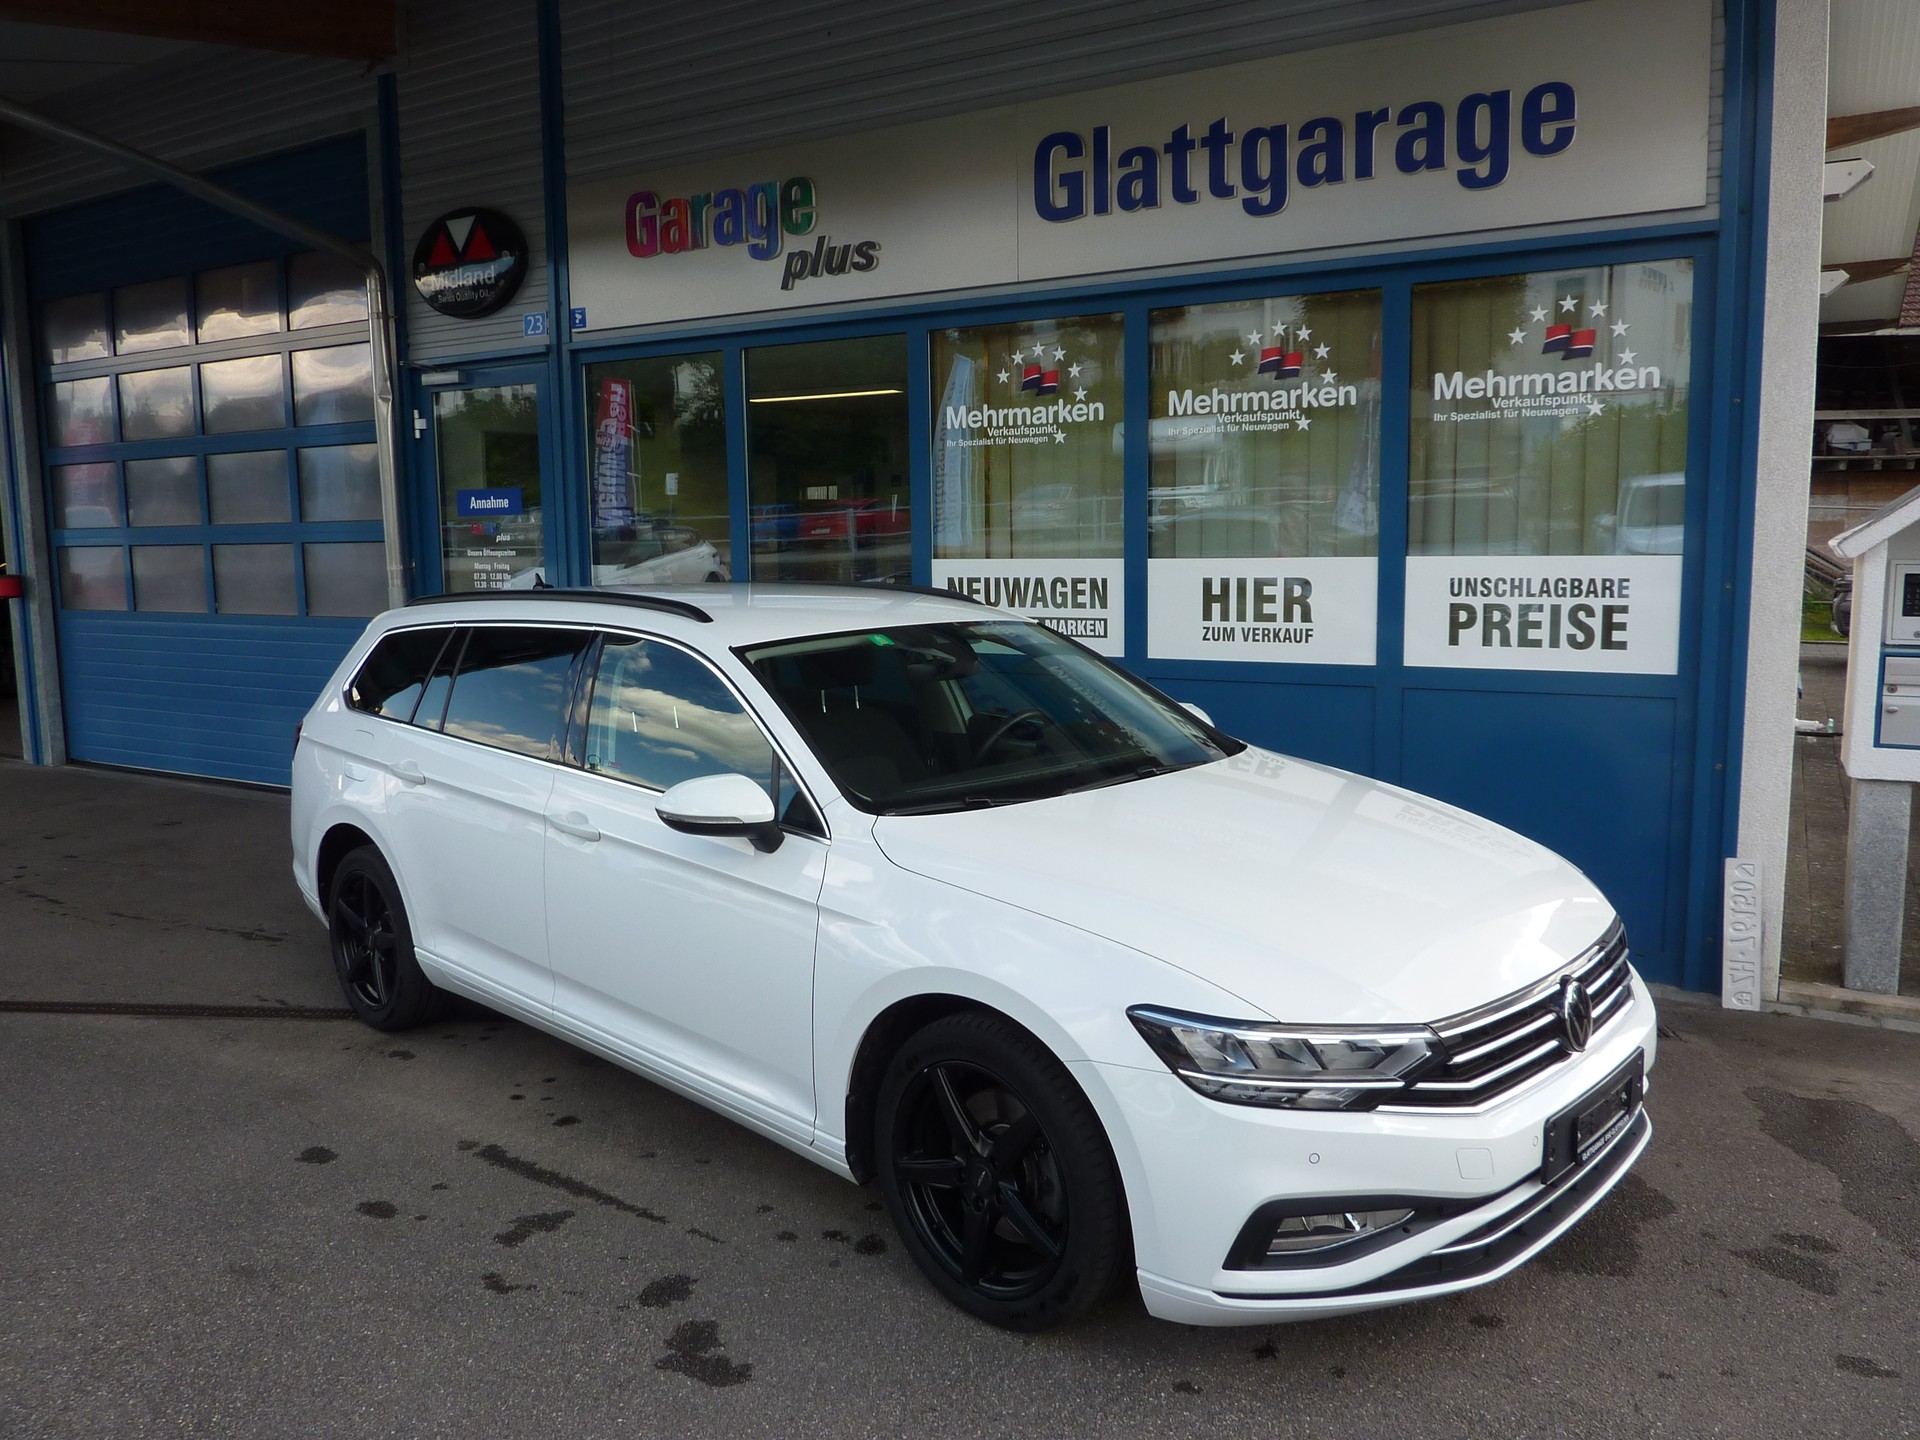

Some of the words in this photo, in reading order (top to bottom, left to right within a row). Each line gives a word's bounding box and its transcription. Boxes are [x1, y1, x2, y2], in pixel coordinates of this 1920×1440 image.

[1034, 80, 1578, 223] Glattgarage
[625, 175, 817, 262] Garage
[780, 235, 881, 291] plus
[431, 264, 495, 291] Midland
[527, 315, 543, 334] 23
[1434, 362, 1661, 400] Mehrmarken
[1168, 381, 1357, 417] Mehrmarken
[1492, 393, 1593, 409] Verkaufspunkt
[946, 398, 1105, 430] Mehrmarken
[1217, 409, 1300, 423] Verkaufspunkt
[1434, 413, 1448, 422] Ihr
[1450, 411, 1501, 423] Spezialist
[1504, 409, 1519, 418] für
[1522, 407, 1579, 417] Neuwagen
[987, 424, 1058, 437] Verkaufspunkt
[1182, 425, 1224, 436] Spezialist
[1227, 423, 1239, 432] für
[1242, 422, 1290, 432] Neuwagen
[958, 438, 994, 448] Spezialist
[1008, 435, 1049, 445] Neuwagen
[470, 495, 509, 509] Annahme
[495, 533, 511, 543] plus
[474, 562, 491, 571] Montag
[494, 562, 510, 571] Freitag
[1450, 577, 1630, 598] UNSCHLAGBARE
[1202, 577, 1314, 623] HIER
[1044, 619, 1105, 636] MARKEN
[1202, 626, 1235, 642] ZUM
[1241, 627, 1314, 643] VERKAUF
[1448, 602, 1630, 650] PREISE
